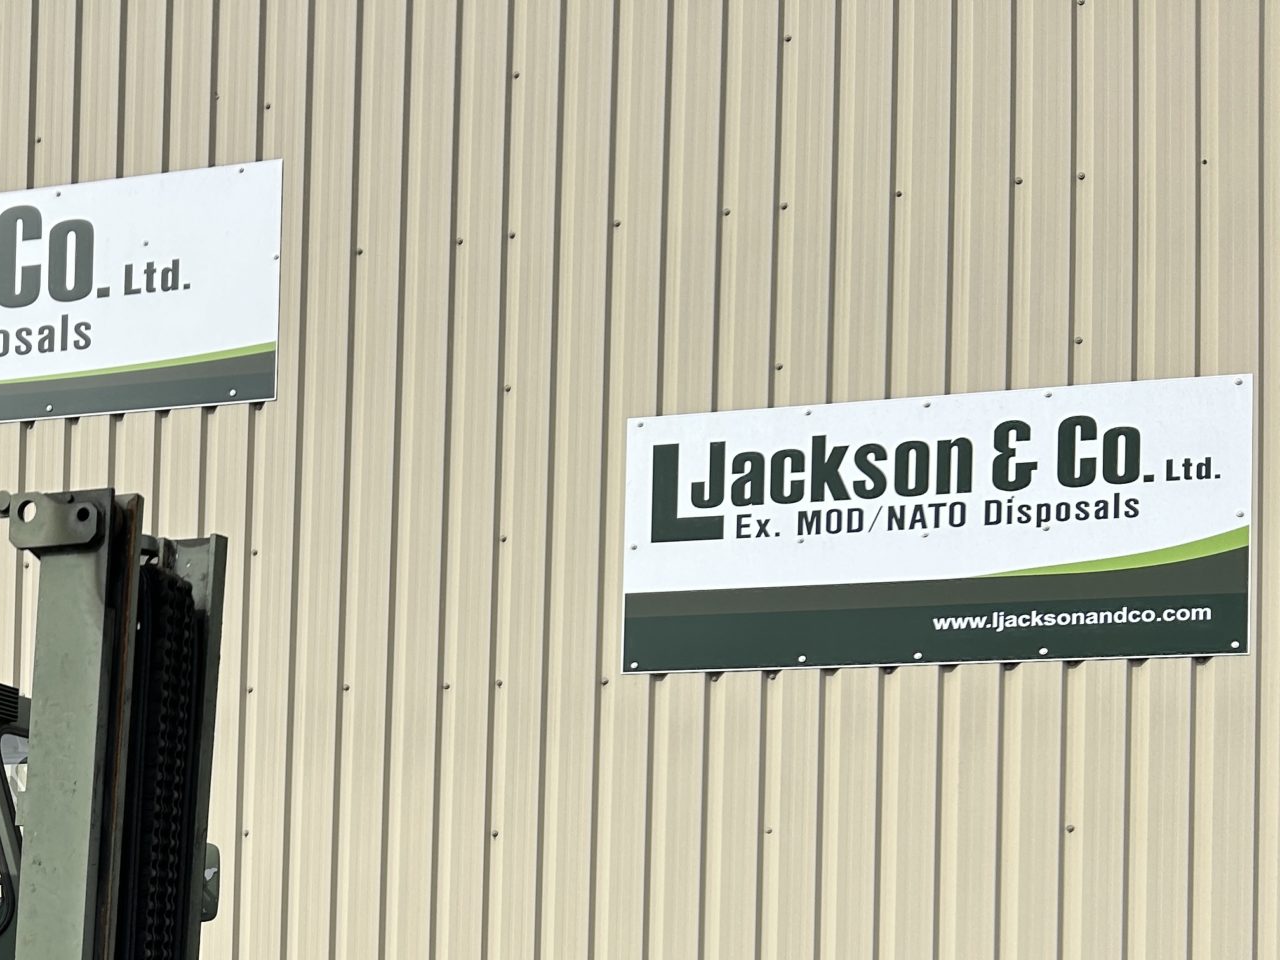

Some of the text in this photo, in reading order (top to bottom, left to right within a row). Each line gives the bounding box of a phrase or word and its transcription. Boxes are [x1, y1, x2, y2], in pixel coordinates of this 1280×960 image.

[124, 259, 190, 296] Ltd.
[992, 420, 1038, 492] &
[1057, 415, 1154, 488] Co.
[1166, 457, 1220, 482] Ltd.
[736, 492, 1139, 539] Ex. MOD/NATO Disposals
[933, 607, 1212, 632] www.ljacksonandco.com
